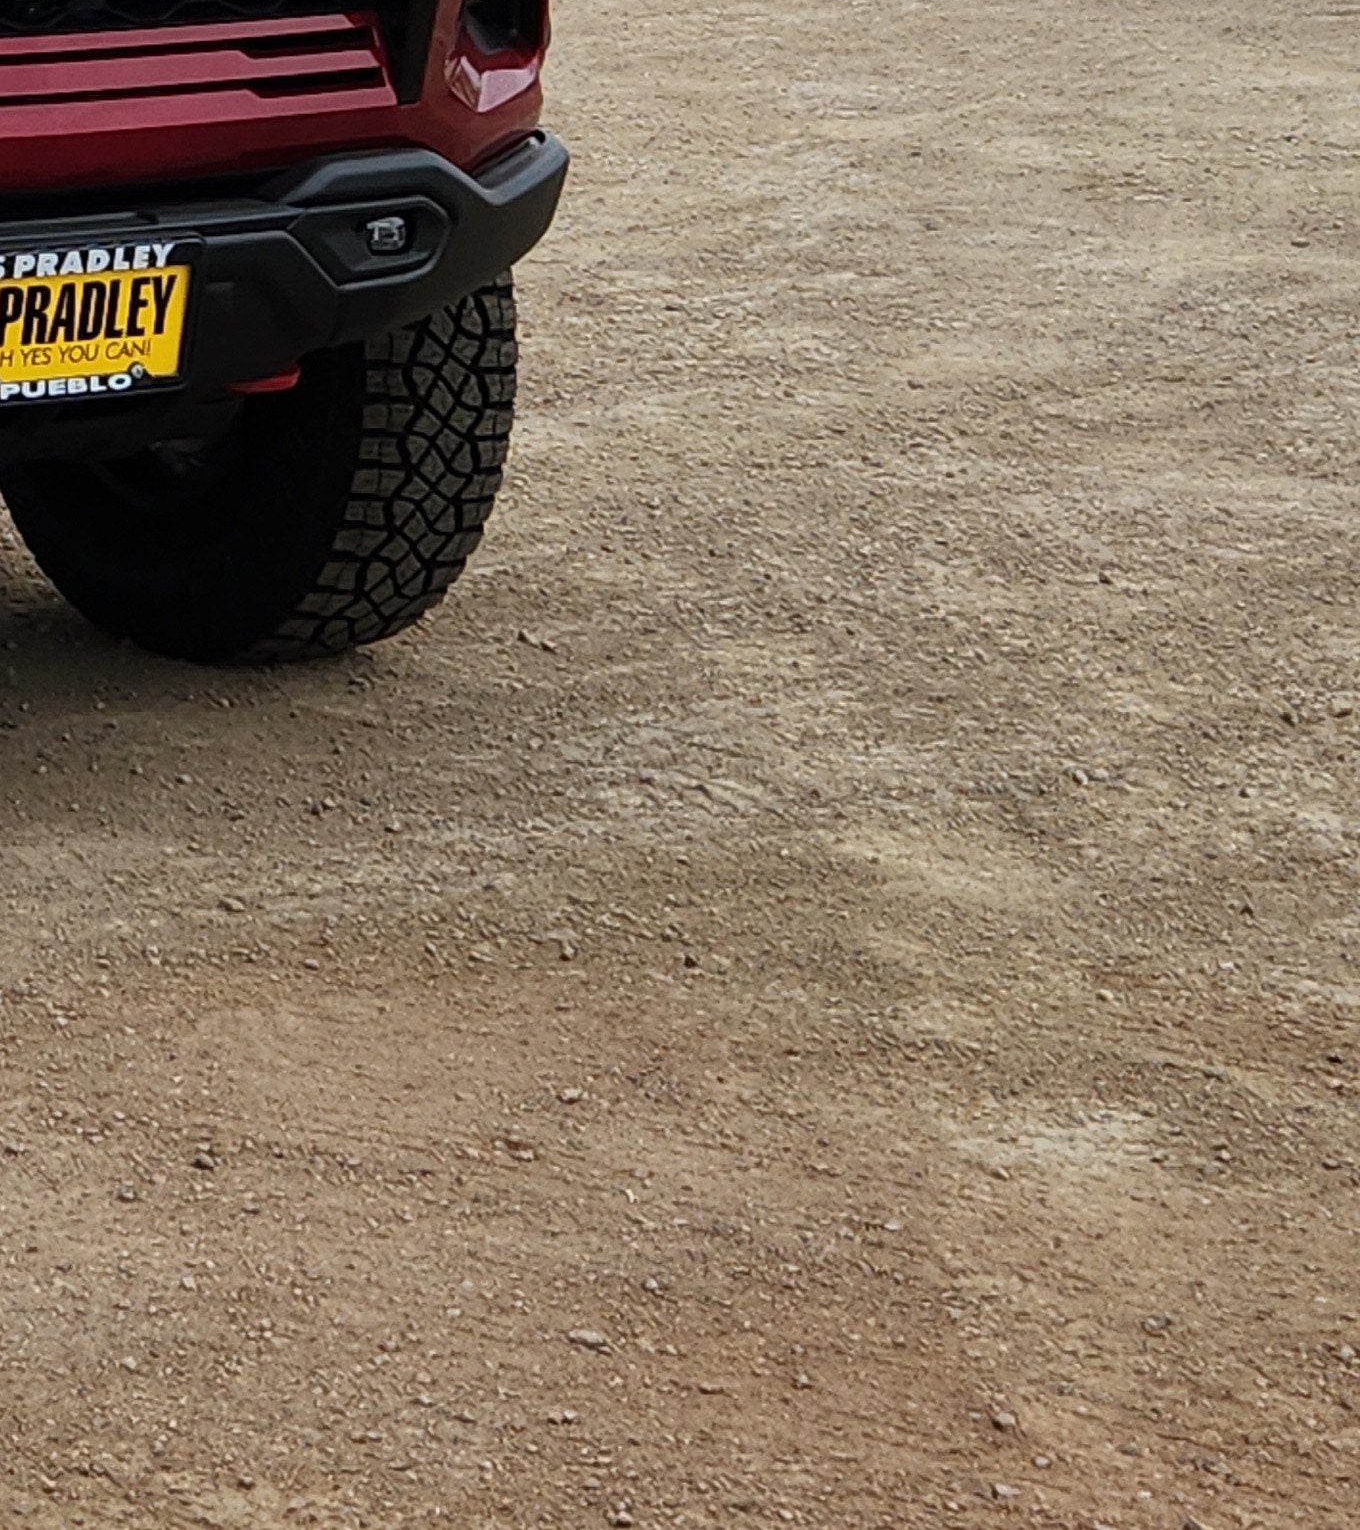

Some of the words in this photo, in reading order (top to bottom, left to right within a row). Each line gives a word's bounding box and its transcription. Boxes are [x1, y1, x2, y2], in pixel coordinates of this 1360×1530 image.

[19, 347, 52, 367] YES
[58, 343, 101, 364] YOU
[105, 338, 152, 359] CAN!
[0, 373, 132, 400] PUEBLO
